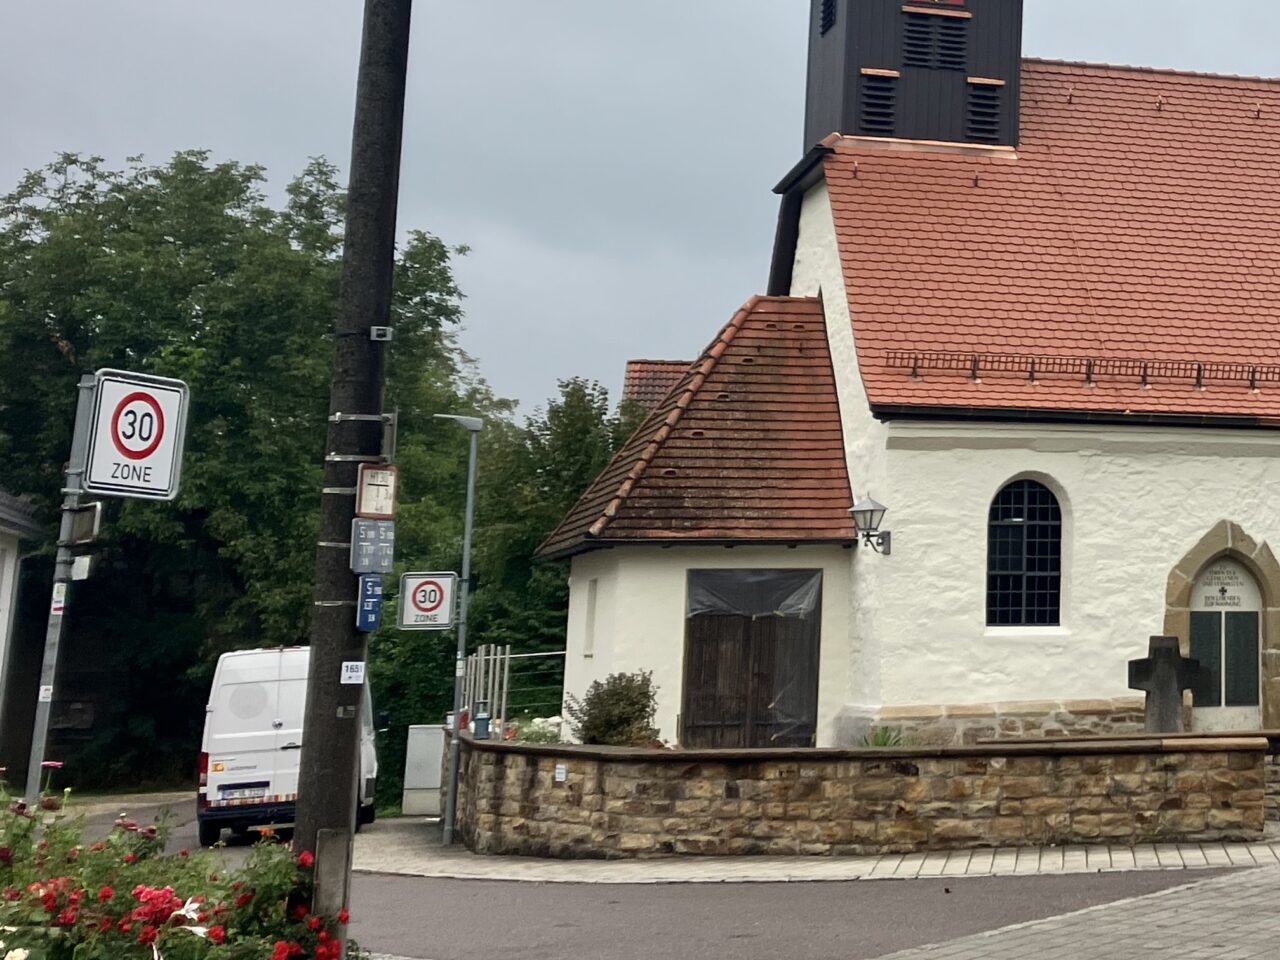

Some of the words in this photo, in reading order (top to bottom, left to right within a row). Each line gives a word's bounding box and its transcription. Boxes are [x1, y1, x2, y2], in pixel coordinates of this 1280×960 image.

[121, 409, 154, 442] 30
[111, 462, 153, 483] ZONE
[418, 589, 437, 604] 30
[414, 614, 439, 623] ZONE
